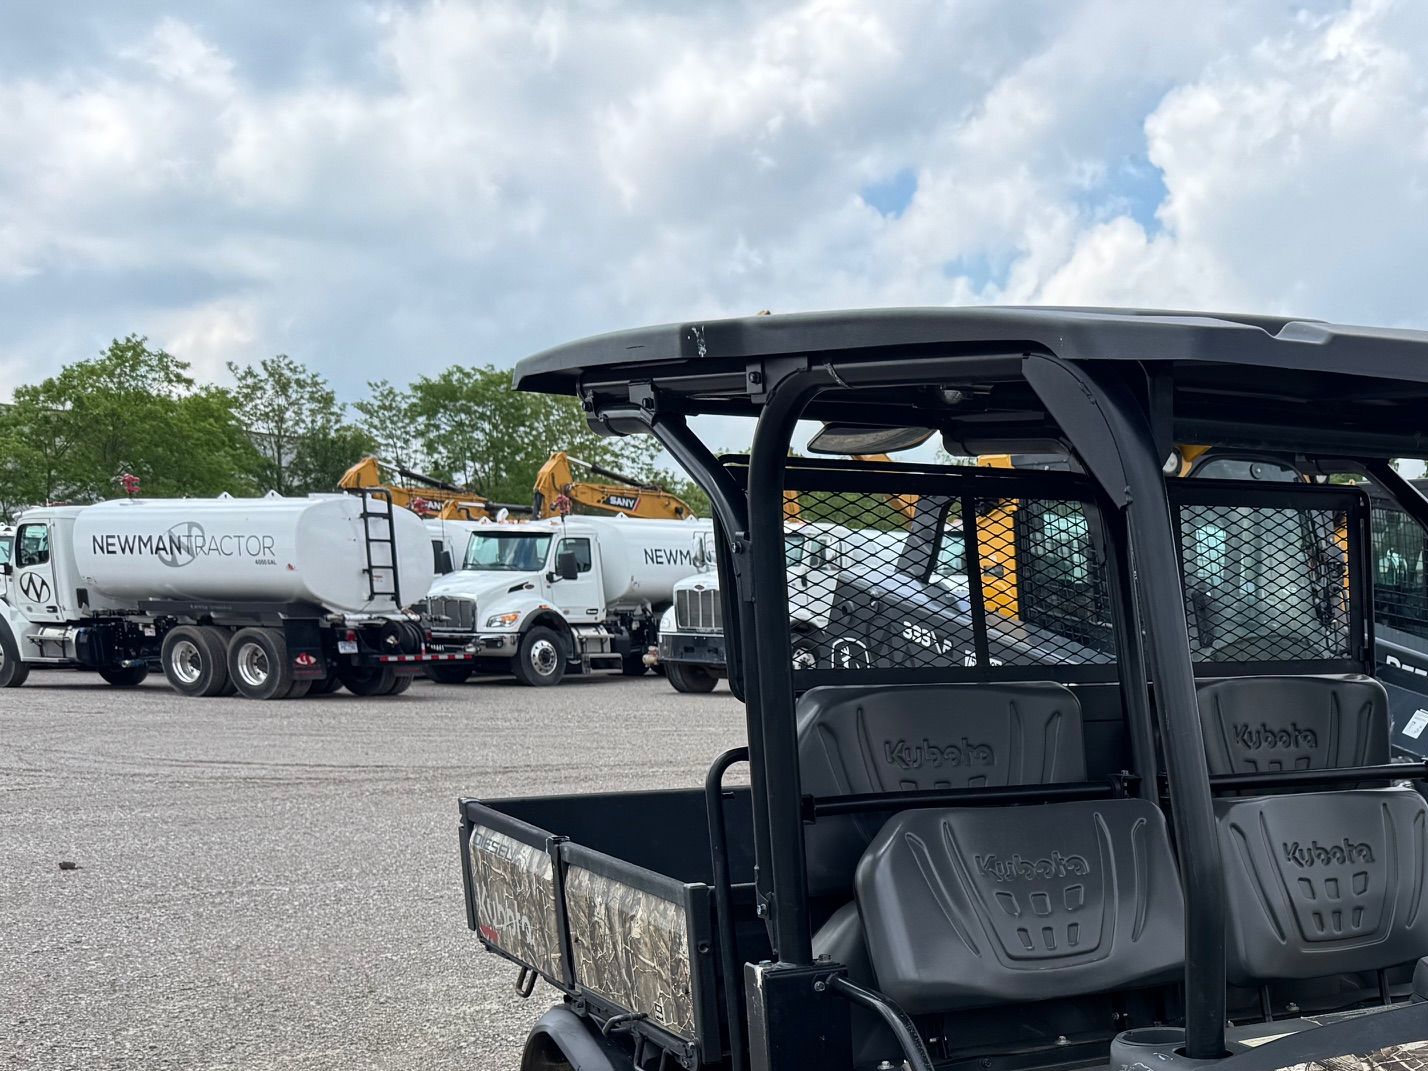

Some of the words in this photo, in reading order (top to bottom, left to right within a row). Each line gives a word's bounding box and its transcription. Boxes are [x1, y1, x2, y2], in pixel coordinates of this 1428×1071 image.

[609, 496, 635, 508] SANY
[1233, 722, 1318, 753] Kubota
[883, 738, 996, 769] Kubota
[474, 832, 514, 862] DIESEL
[1284, 838, 1374, 870] Kubota
[976, 851, 1089, 881] Kubota
